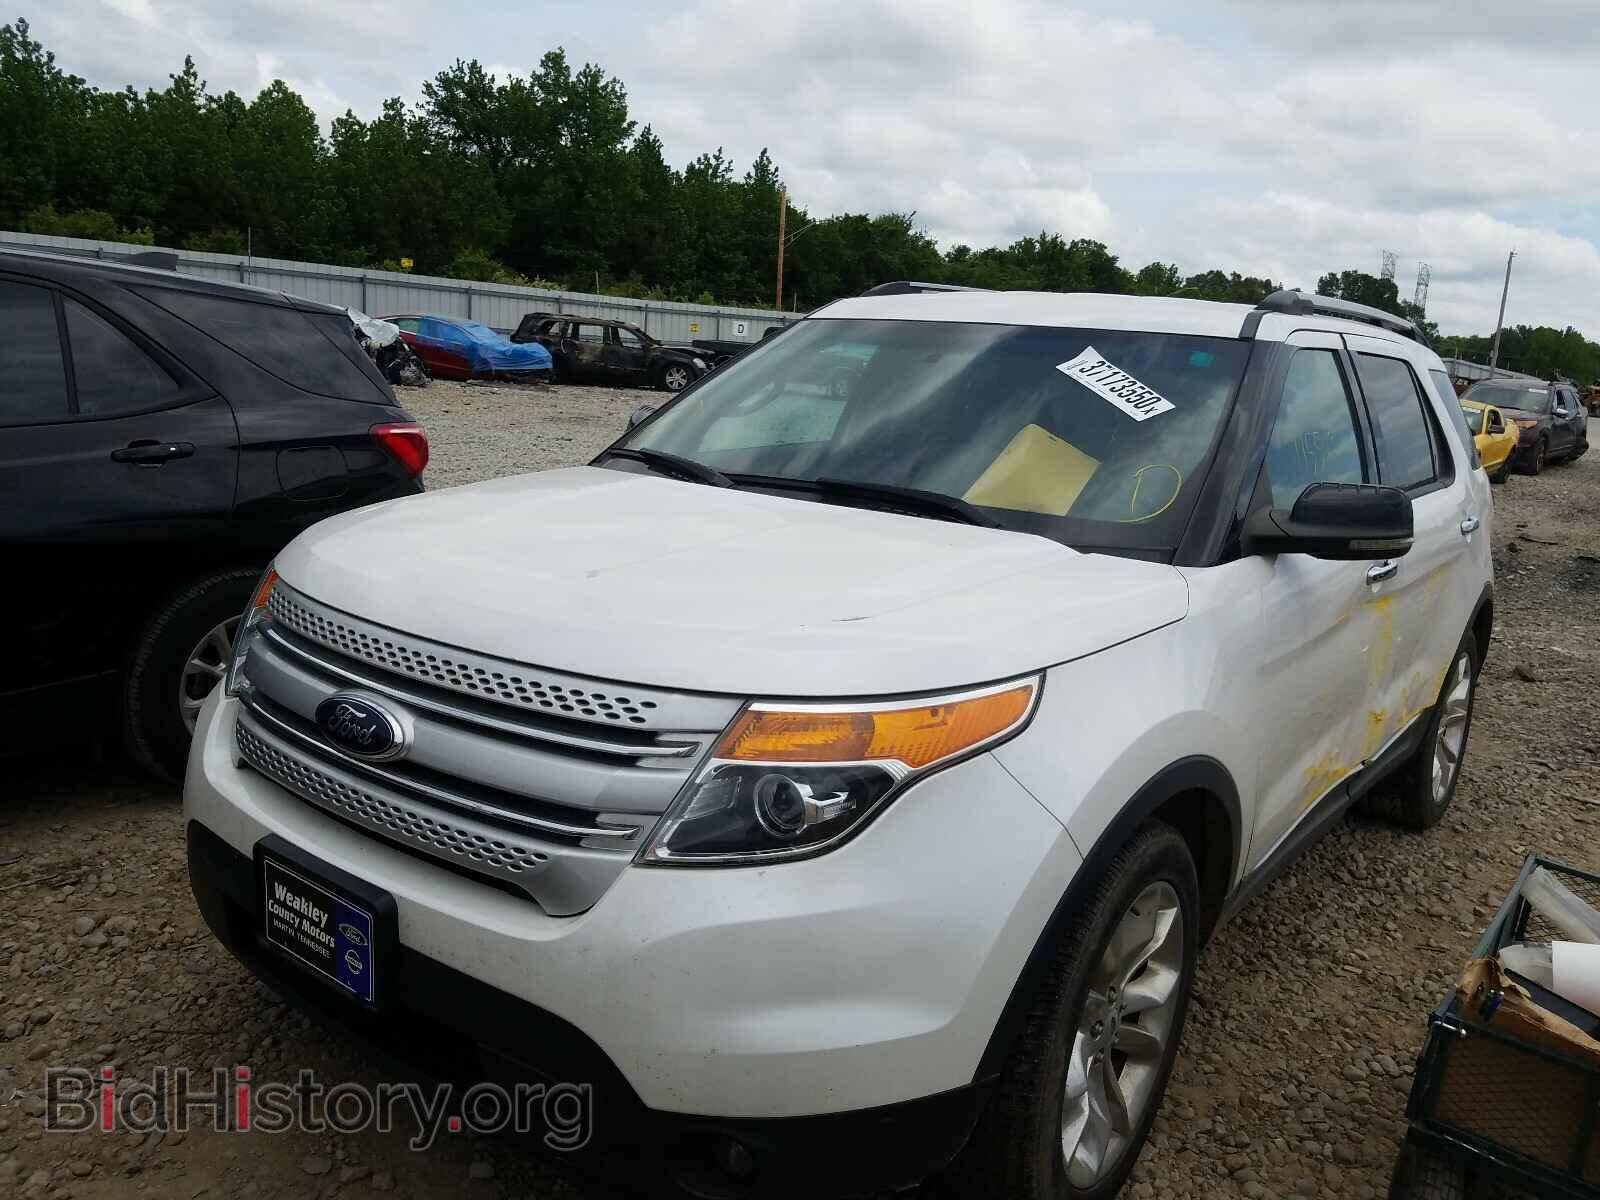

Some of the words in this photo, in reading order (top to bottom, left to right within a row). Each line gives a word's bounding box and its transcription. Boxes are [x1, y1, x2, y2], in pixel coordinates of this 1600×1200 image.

[737, 323, 745, 334] D
[328, 703, 377, 745] Ford
[268, 899, 300, 927] County
[301, 919, 335, 948] Motors
[274, 881, 329, 928] Weakley
[297, 932, 331, 959] TENNESSEE
